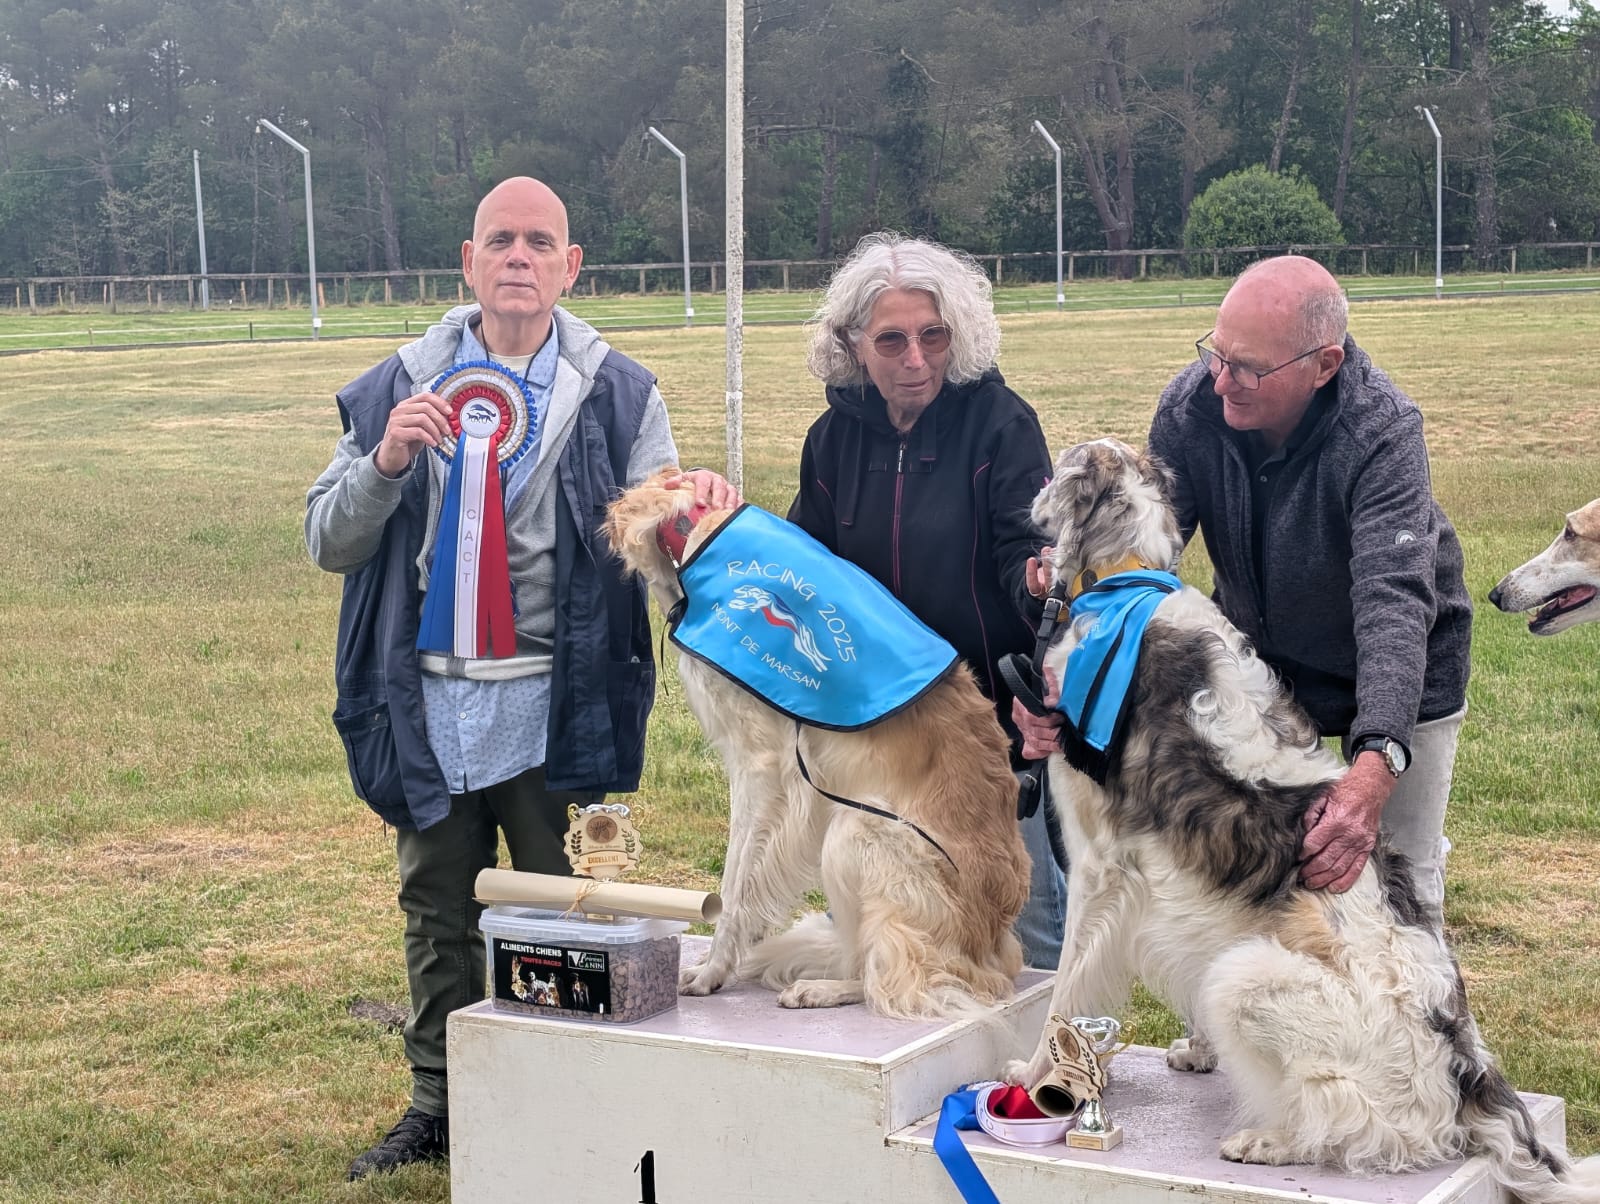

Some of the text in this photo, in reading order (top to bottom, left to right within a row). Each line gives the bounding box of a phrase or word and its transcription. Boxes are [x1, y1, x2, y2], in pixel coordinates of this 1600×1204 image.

[462, 508, 477, 584] CACT
[711, 602, 821, 691] MONT DE MARSAN
[726, 559, 857, 662] RACING 2025
[500, 942, 562, 957] ALIMENTS CHIENS
